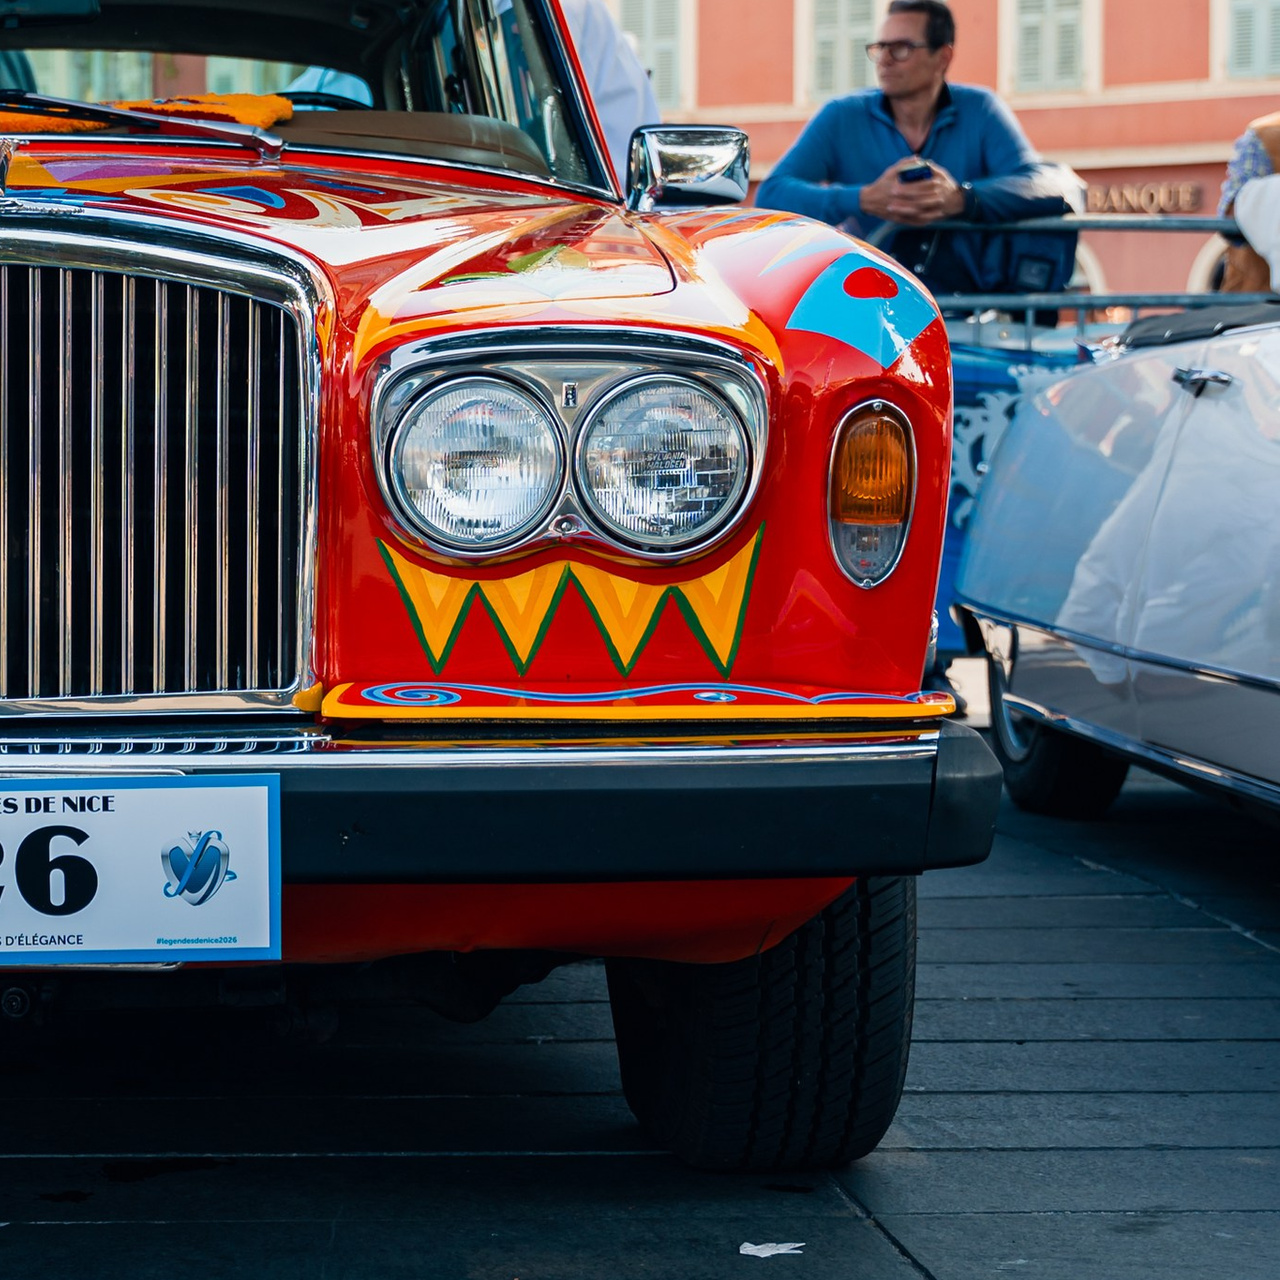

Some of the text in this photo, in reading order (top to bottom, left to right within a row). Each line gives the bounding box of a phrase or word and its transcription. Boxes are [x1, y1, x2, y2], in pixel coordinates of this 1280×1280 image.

[1087, 182, 1200, 214] BANQUE
[24, 796, 56, 814] DE
[62, 795, 116, 813] NICE
[156, 936, 238, 946] #legendesdenice2026
